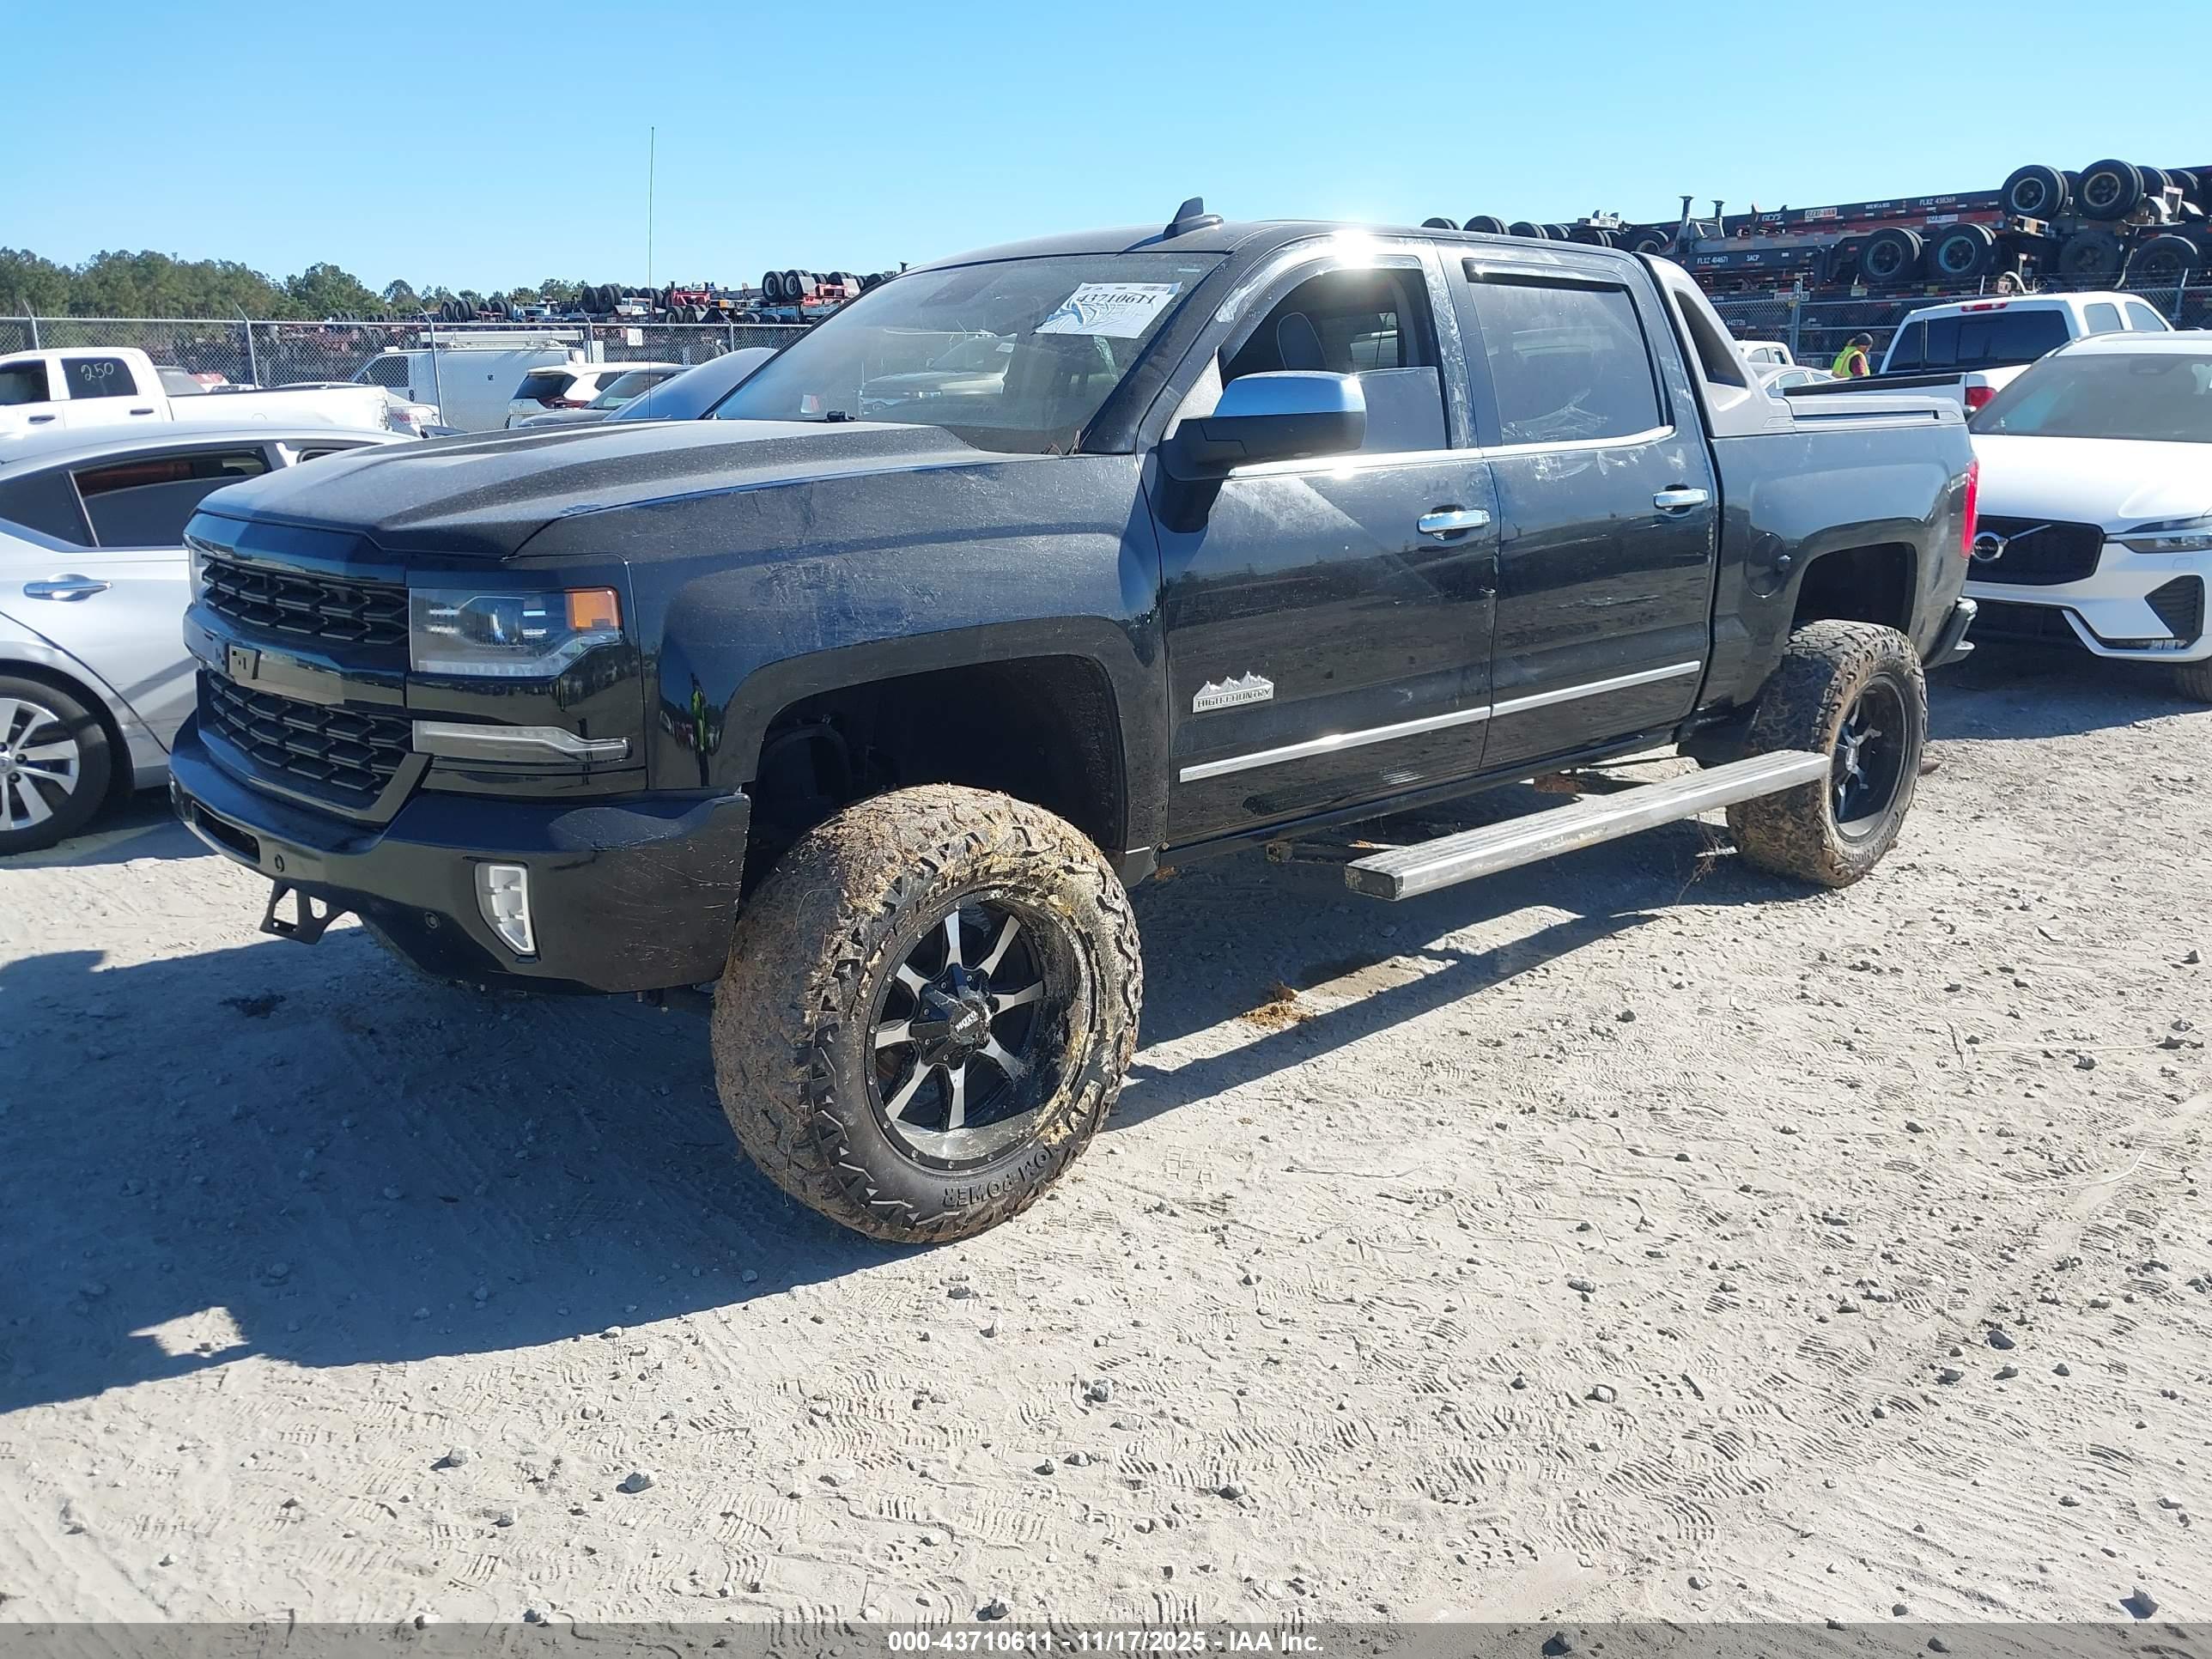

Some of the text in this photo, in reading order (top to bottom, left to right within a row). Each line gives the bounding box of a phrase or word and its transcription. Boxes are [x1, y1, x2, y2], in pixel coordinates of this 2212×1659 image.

[1077, 294, 1158, 304] 43710611
[629, 331, 641, 344] 20
[81, 362, 114, 381] 250
[955, 1011, 977, 1032] MOTO
[941, 1173, 1018, 1208] POWER
